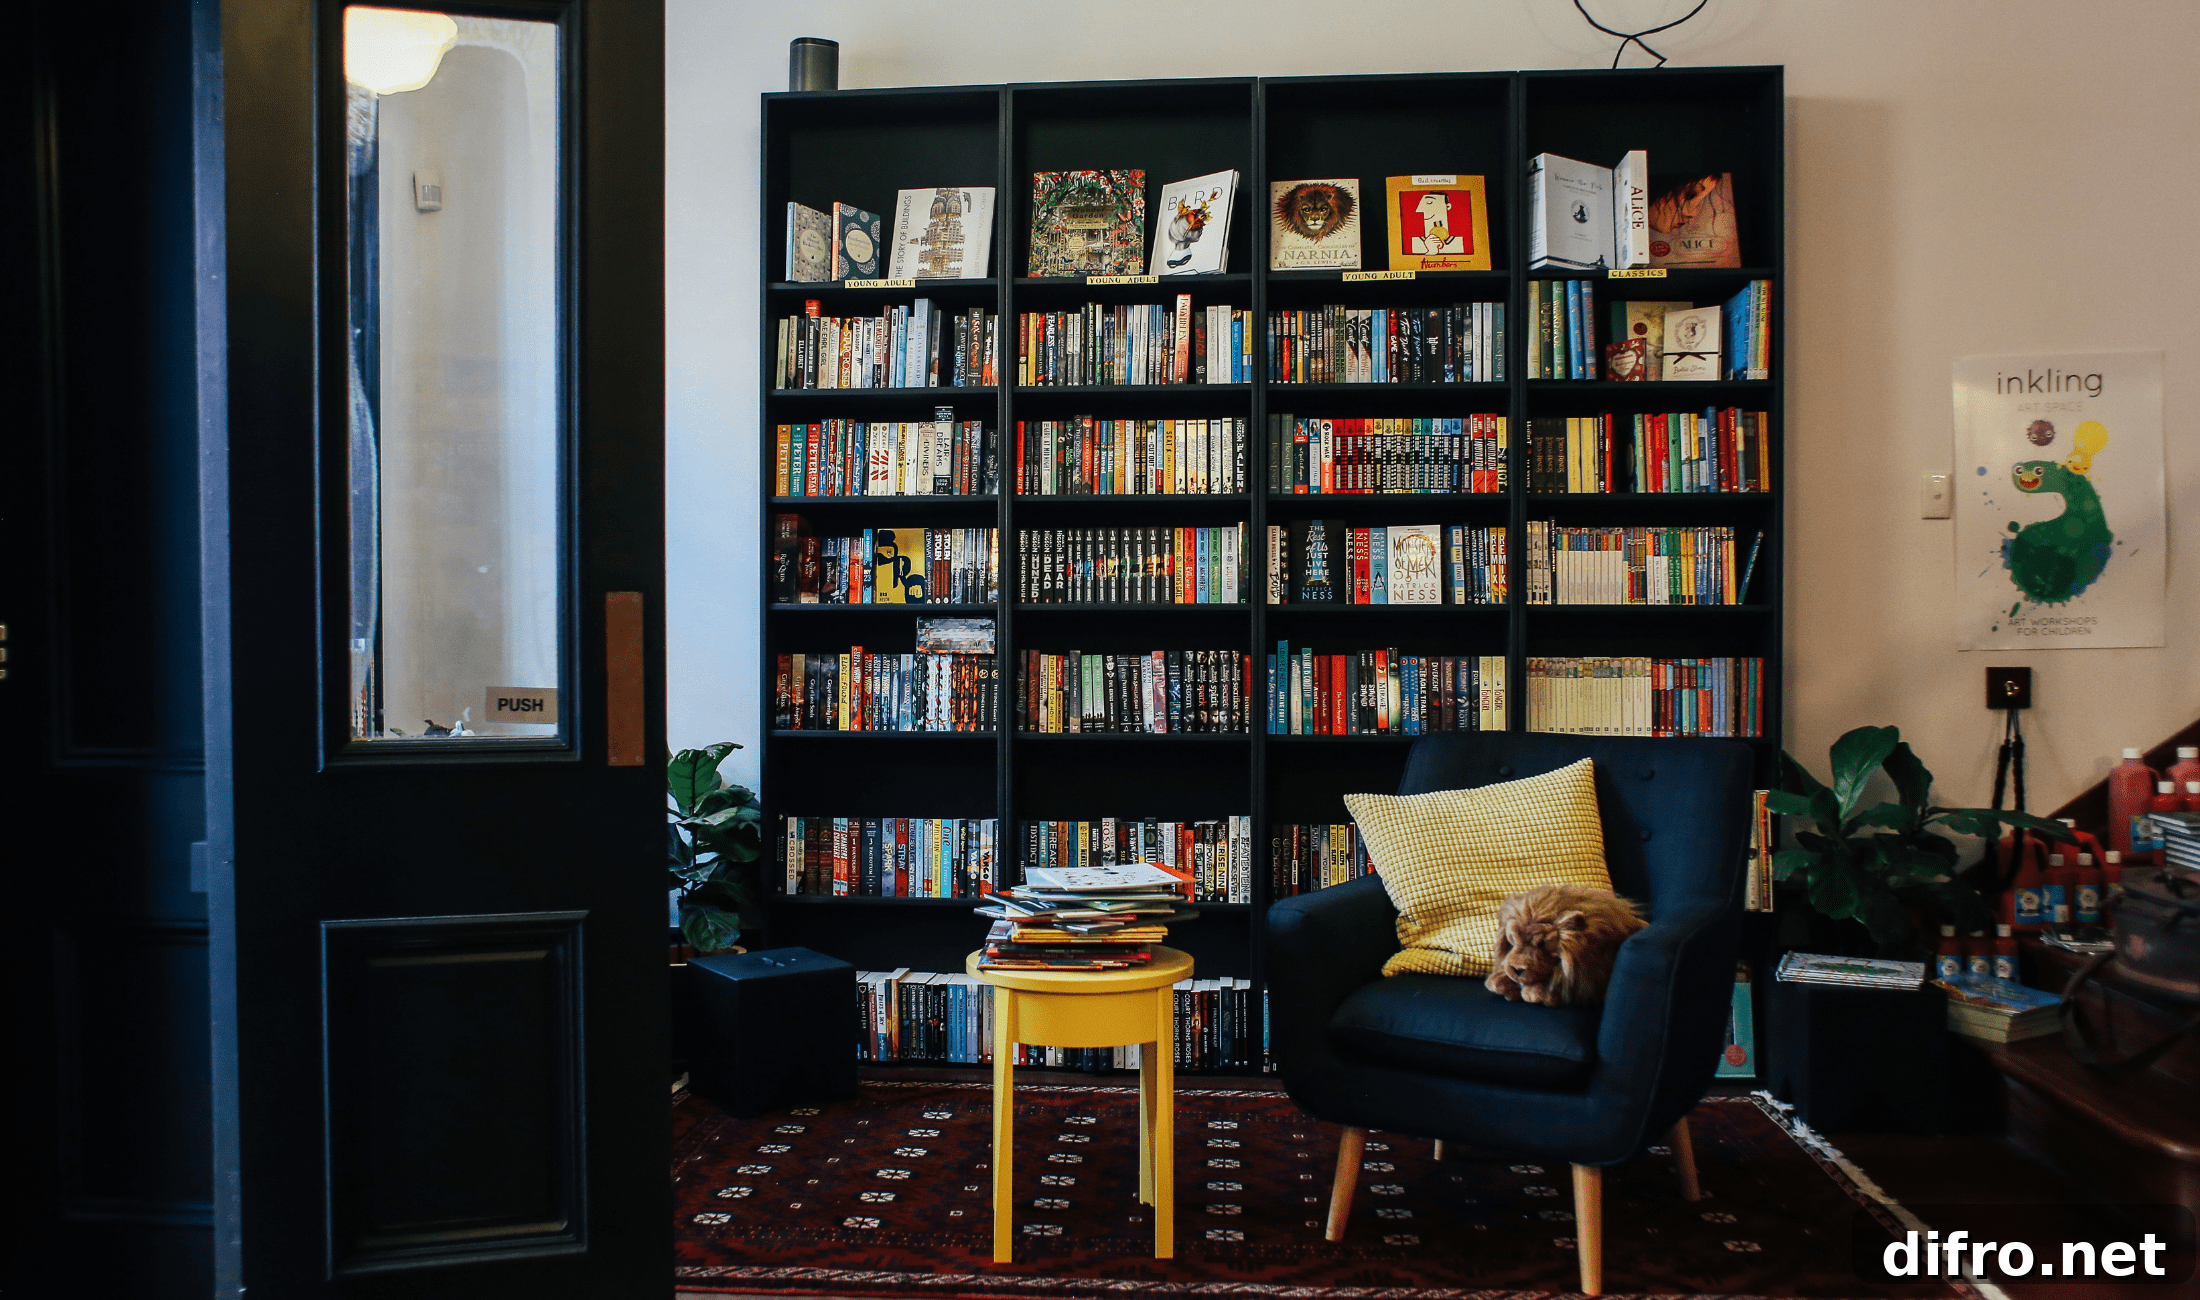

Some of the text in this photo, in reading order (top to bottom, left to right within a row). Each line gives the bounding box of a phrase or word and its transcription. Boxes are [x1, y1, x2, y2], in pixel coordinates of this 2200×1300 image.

[1168, 187, 1223, 210] BIRD
[895, 195, 911, 278] THE STORY OF BUILDINGS
[1284, 250, 1352, 260] NARNIA
[1420, 258, 1457, 269] Numbers
[822, 321, 827, 331] ME
[1400, 337, 1410, 355] Dark
[840, 331, 851, 387] STARCROSSED
[1997, 369, 2103, 398] inkling
[2018, 402, 2083, 412] ART SPACE
[780, 443, 788, 474] PETER
[793, 442, 802, 474] PETER
[809, 443, 818, 474] PETER
[1474, 438, 1483, 470] LIQUIDATOR
[1486, 438, 1496, 470] LIQUIDATOR
[1498, 463, 1507, 486] RIOT
[1306, 532, 1325, 542] Rest
[1394, 590, 1436, 600] NESS
[2030, 617, 2098, 626] WORKSHOPS
[2040, 627, 2092, 635] CHILDREN
[498, 698, 543, 711] PUSH
[1197, 684, 1206, 706] spark
[1210, 685, 1218, 707] spirit
[942, 826, 951, 846] One
[1323, 878, 1327, 886] ME
